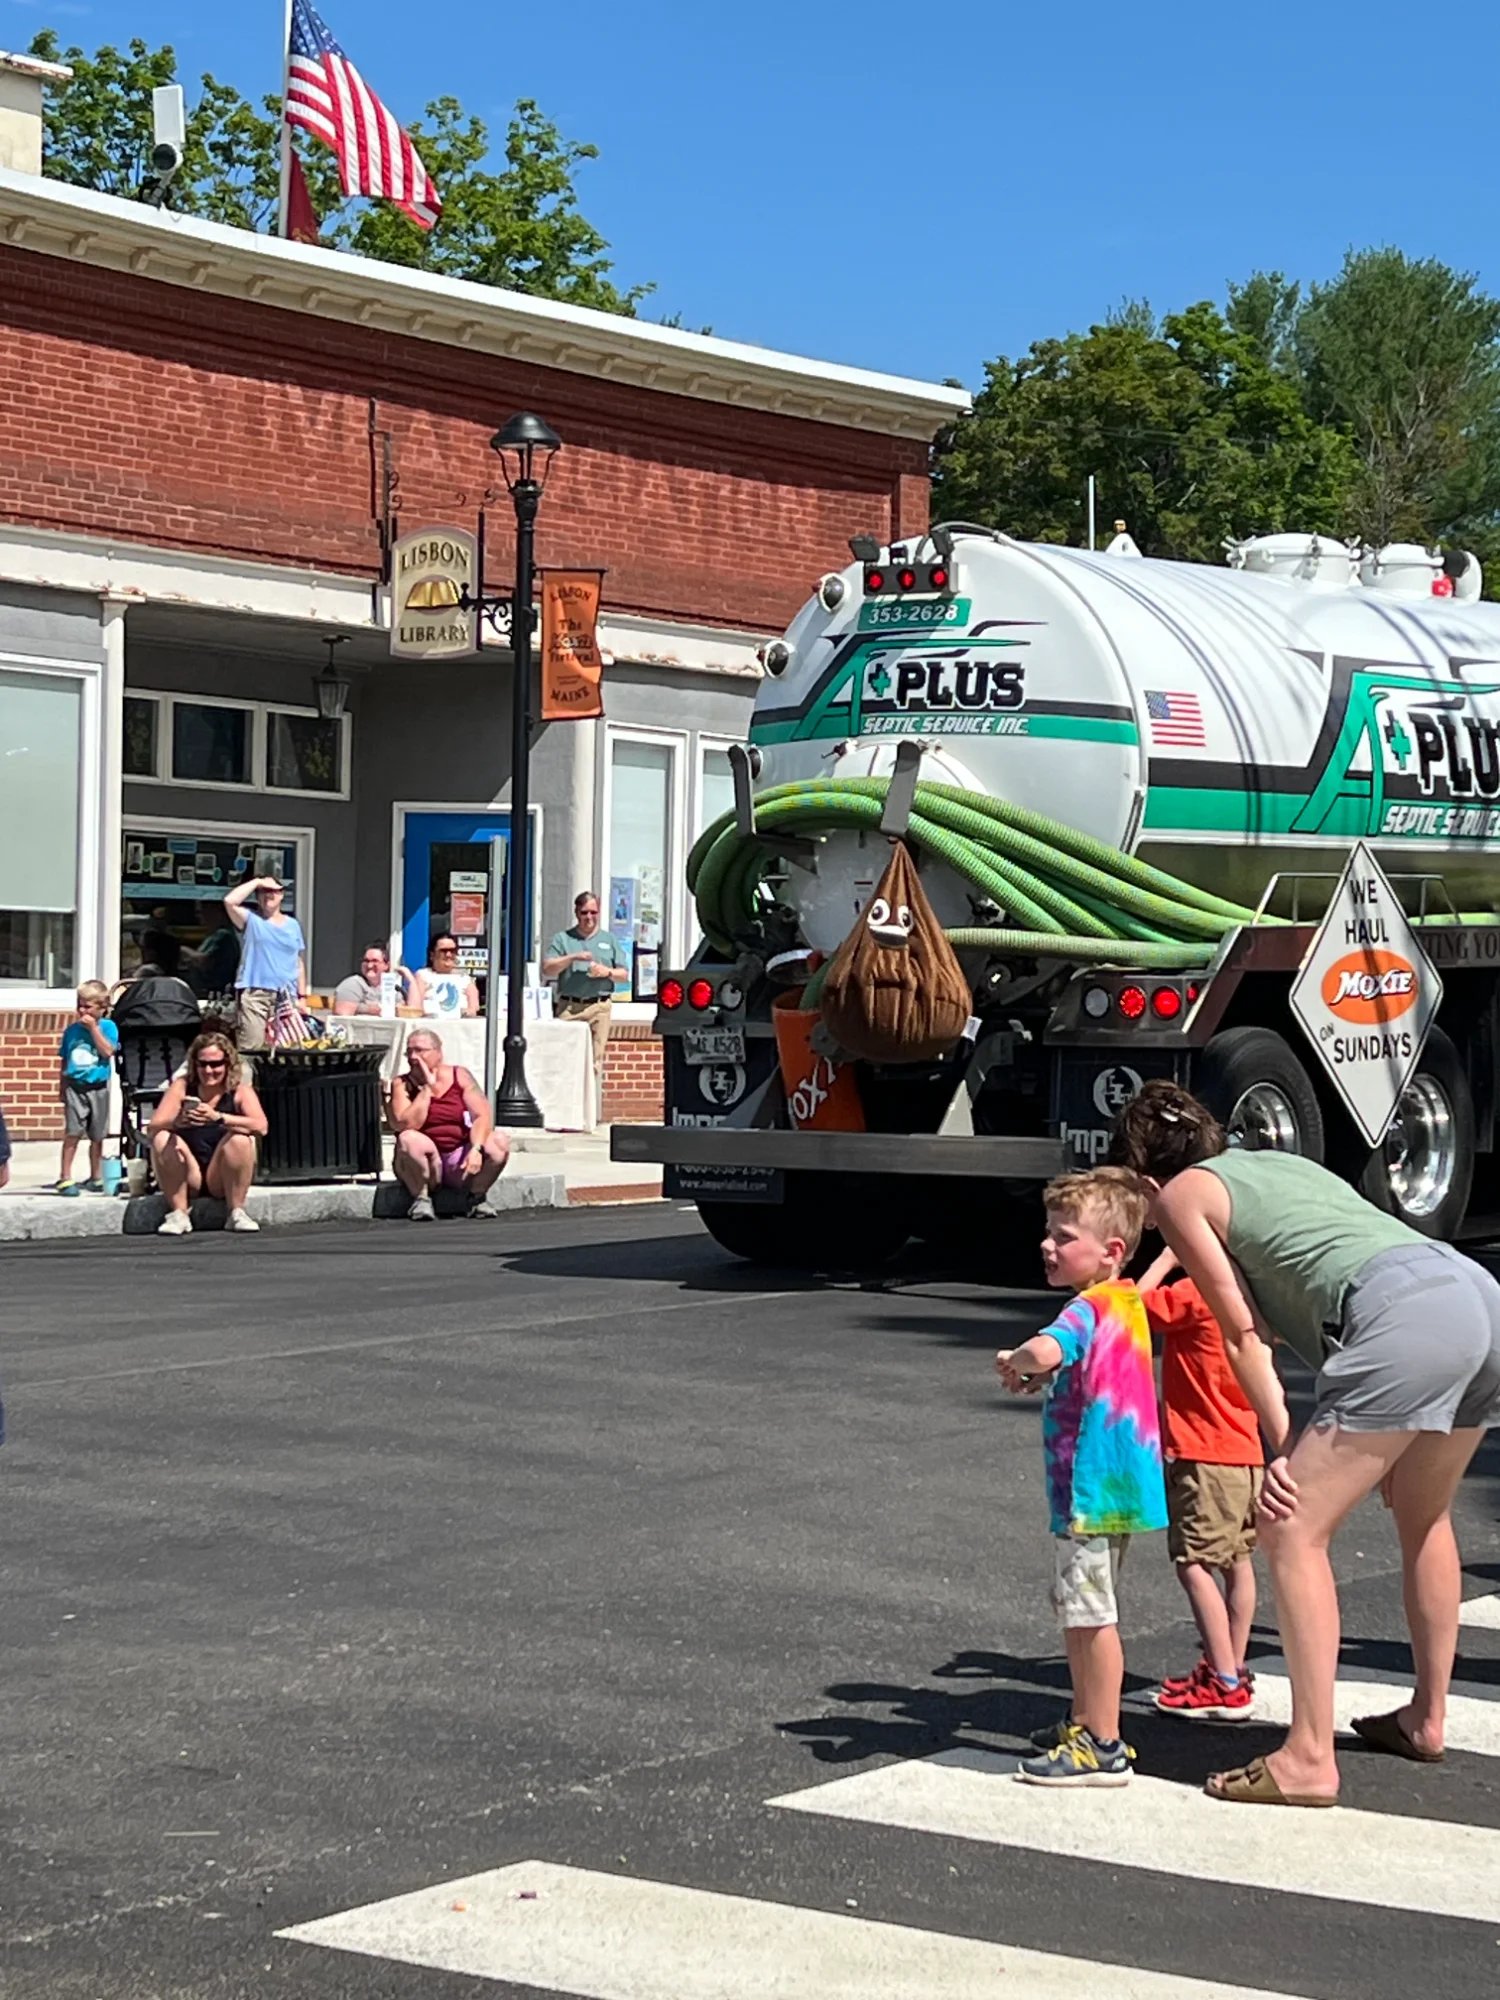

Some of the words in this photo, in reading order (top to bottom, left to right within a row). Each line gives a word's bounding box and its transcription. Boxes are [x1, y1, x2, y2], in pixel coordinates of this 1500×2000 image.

[401, 541, 469, 571] LISBON
[400, 625, 470, 643] LIBRARY
[551, 686, 590, 702] MAINE
[896, 660, 1026, 710] PLUS
[863, 716, 917, 735] SEPTIC
[1382, 804, 1443, 834] SEPTIC
[1350, 879, 1378, 905] WE
[1345, 918, 1389, 945] HAUL
[1421, 931, 1469, 960] TING
[1473, 931, 1500, 960] YO
[1330, 968, 1413, 1006] MOXIE
[1334, 1032, 1411, 1064] SUNDAYS
[787, 1055, 838, 1130] OXI
